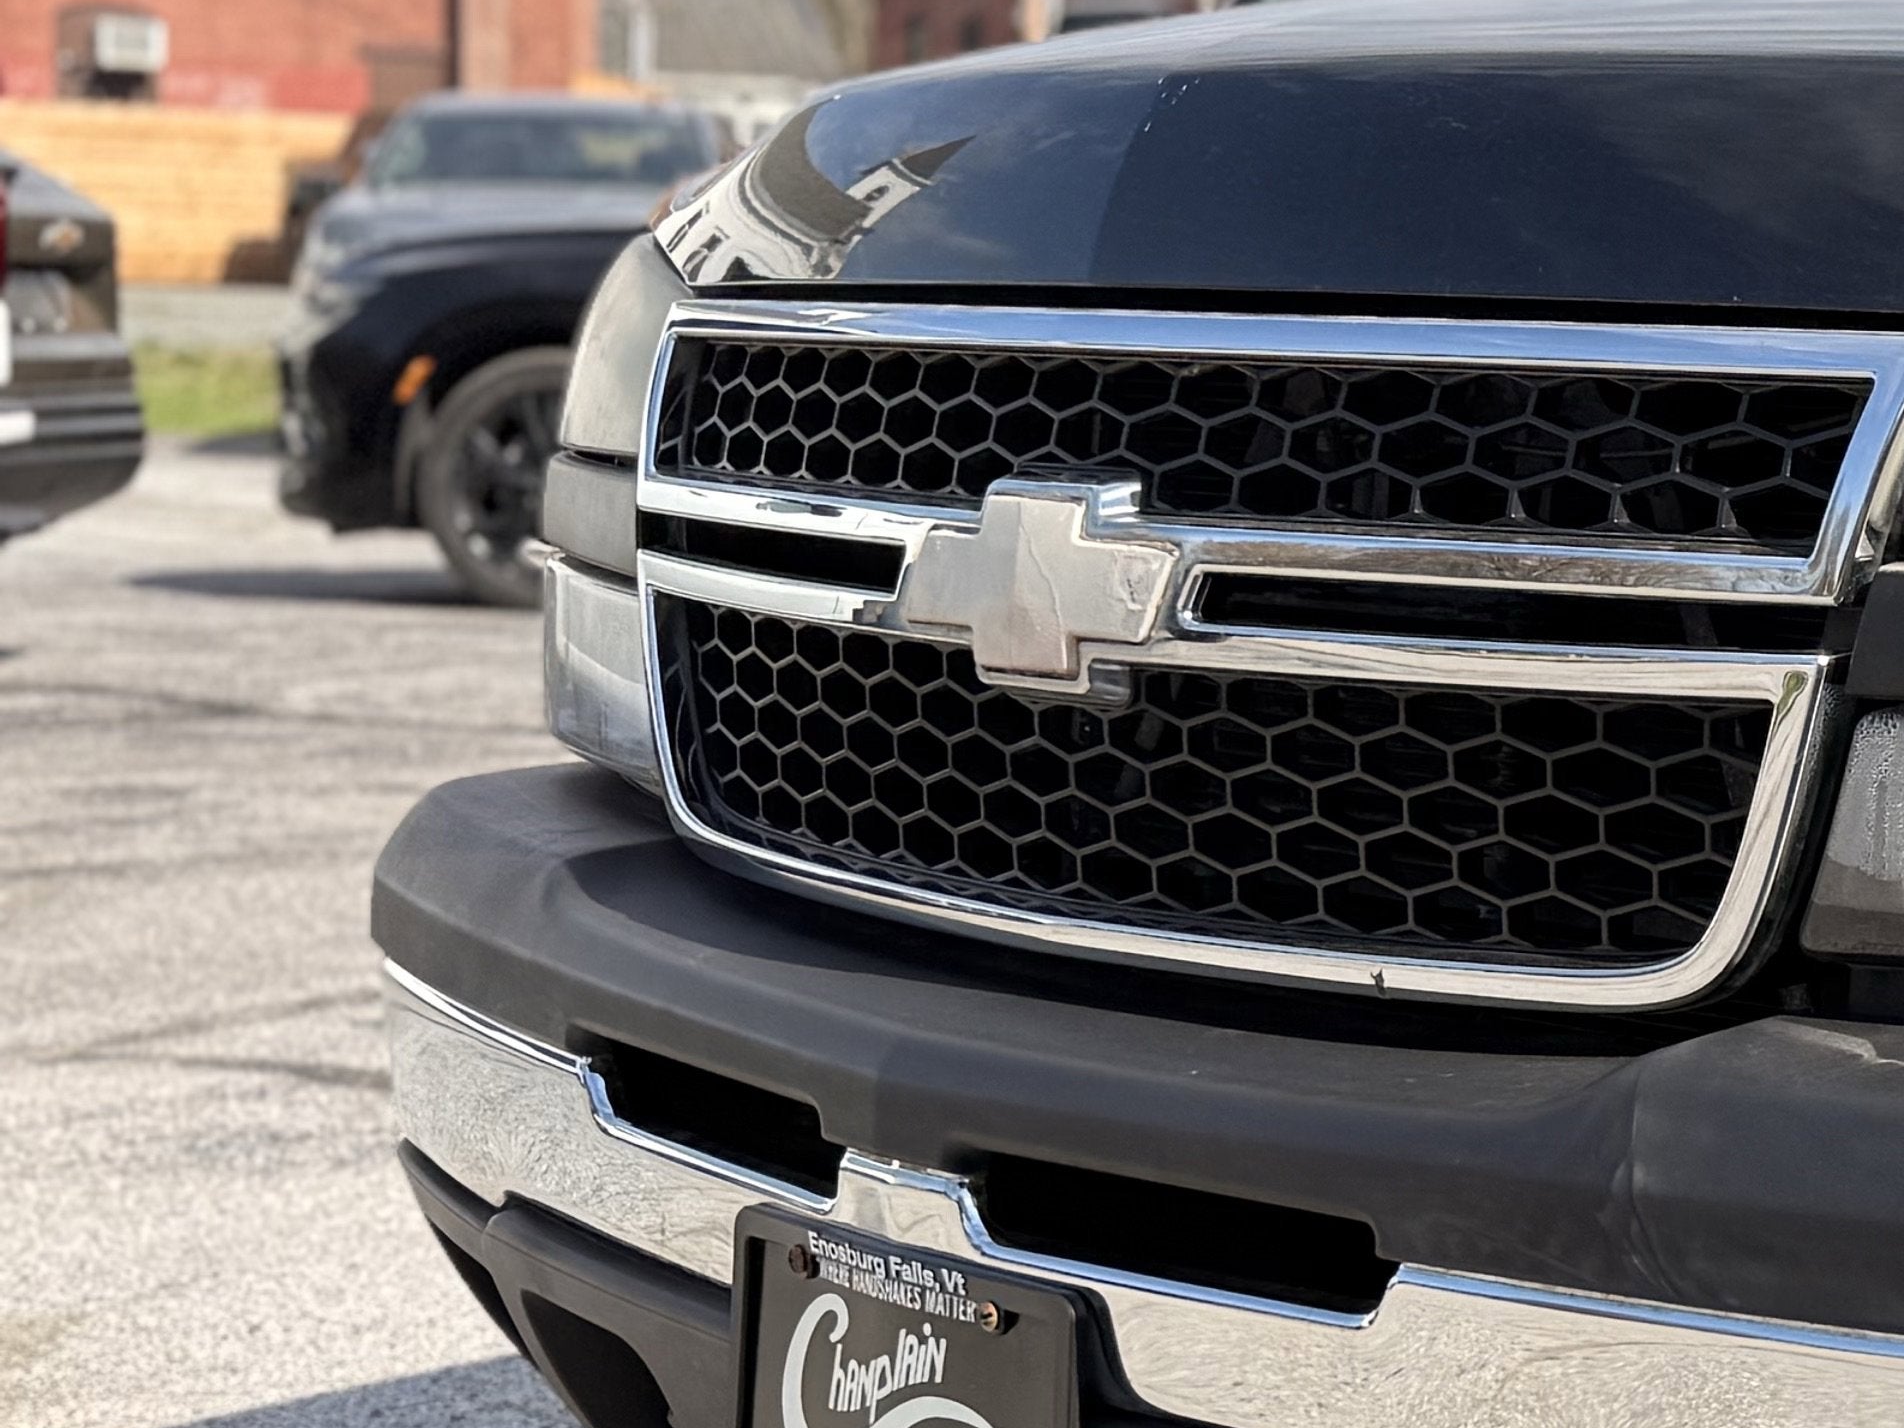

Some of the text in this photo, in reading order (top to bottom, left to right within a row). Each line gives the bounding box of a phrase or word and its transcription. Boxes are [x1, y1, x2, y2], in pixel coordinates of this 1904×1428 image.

[807, 1229, 968, 1296] Enosburg Falls, Vt
[851, 1267, 923, 1312] HANDSHAKES
